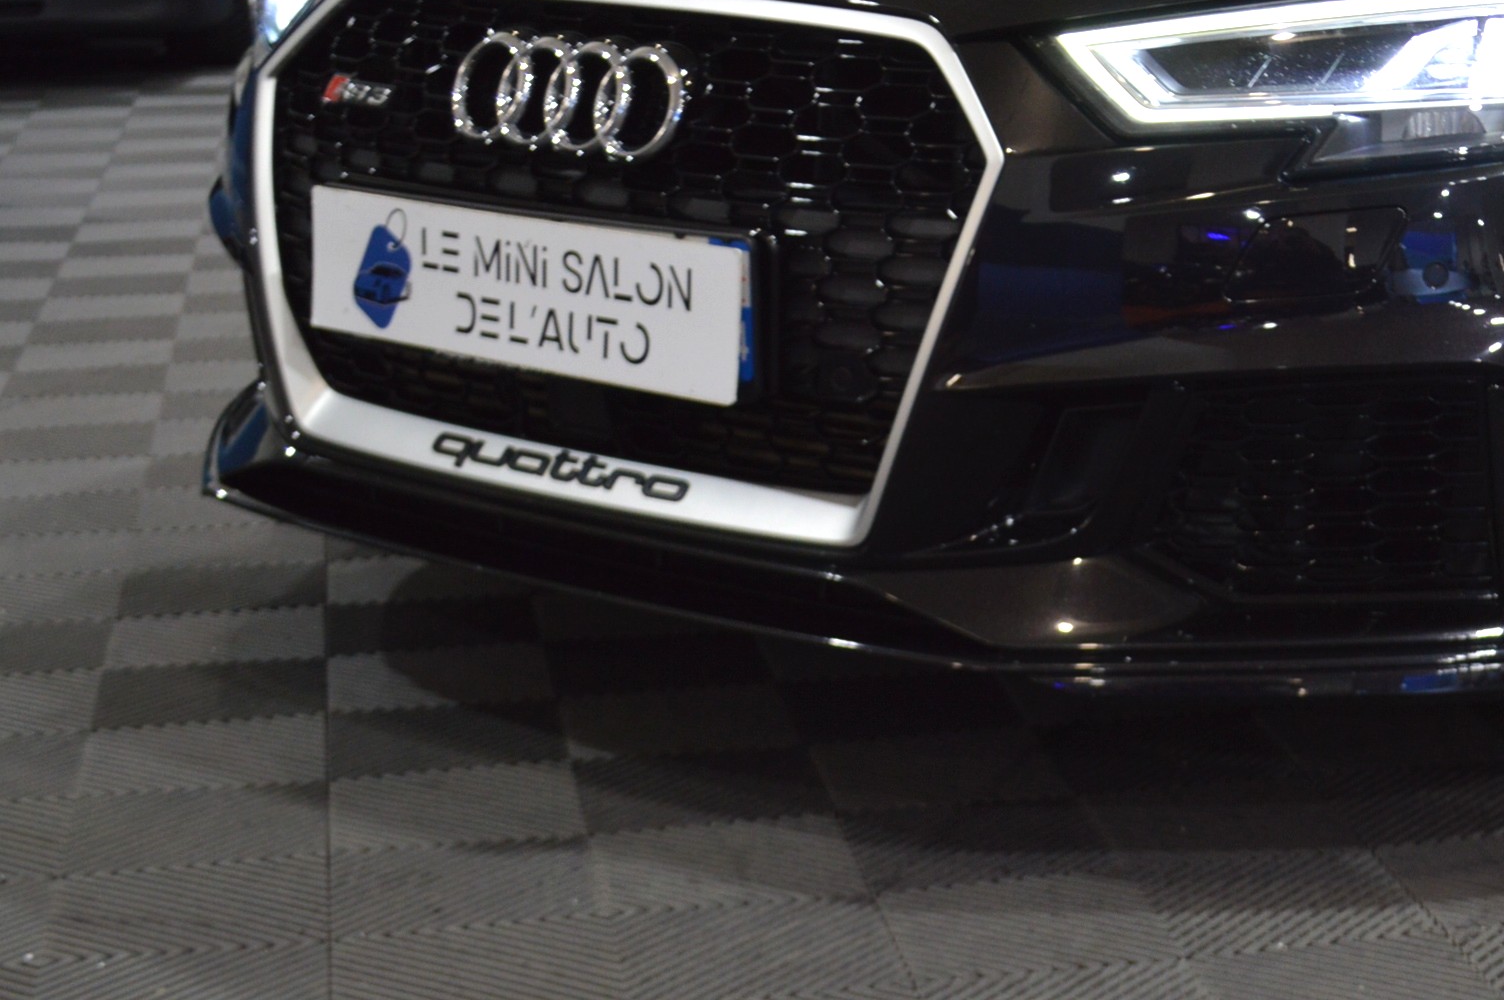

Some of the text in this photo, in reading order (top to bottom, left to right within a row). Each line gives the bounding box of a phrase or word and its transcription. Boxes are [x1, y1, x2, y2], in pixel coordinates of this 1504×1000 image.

[422, 227, 460, 273] LE
[561, 249, 692, 312] SALON
[432, 431, 690, 502] quattro
